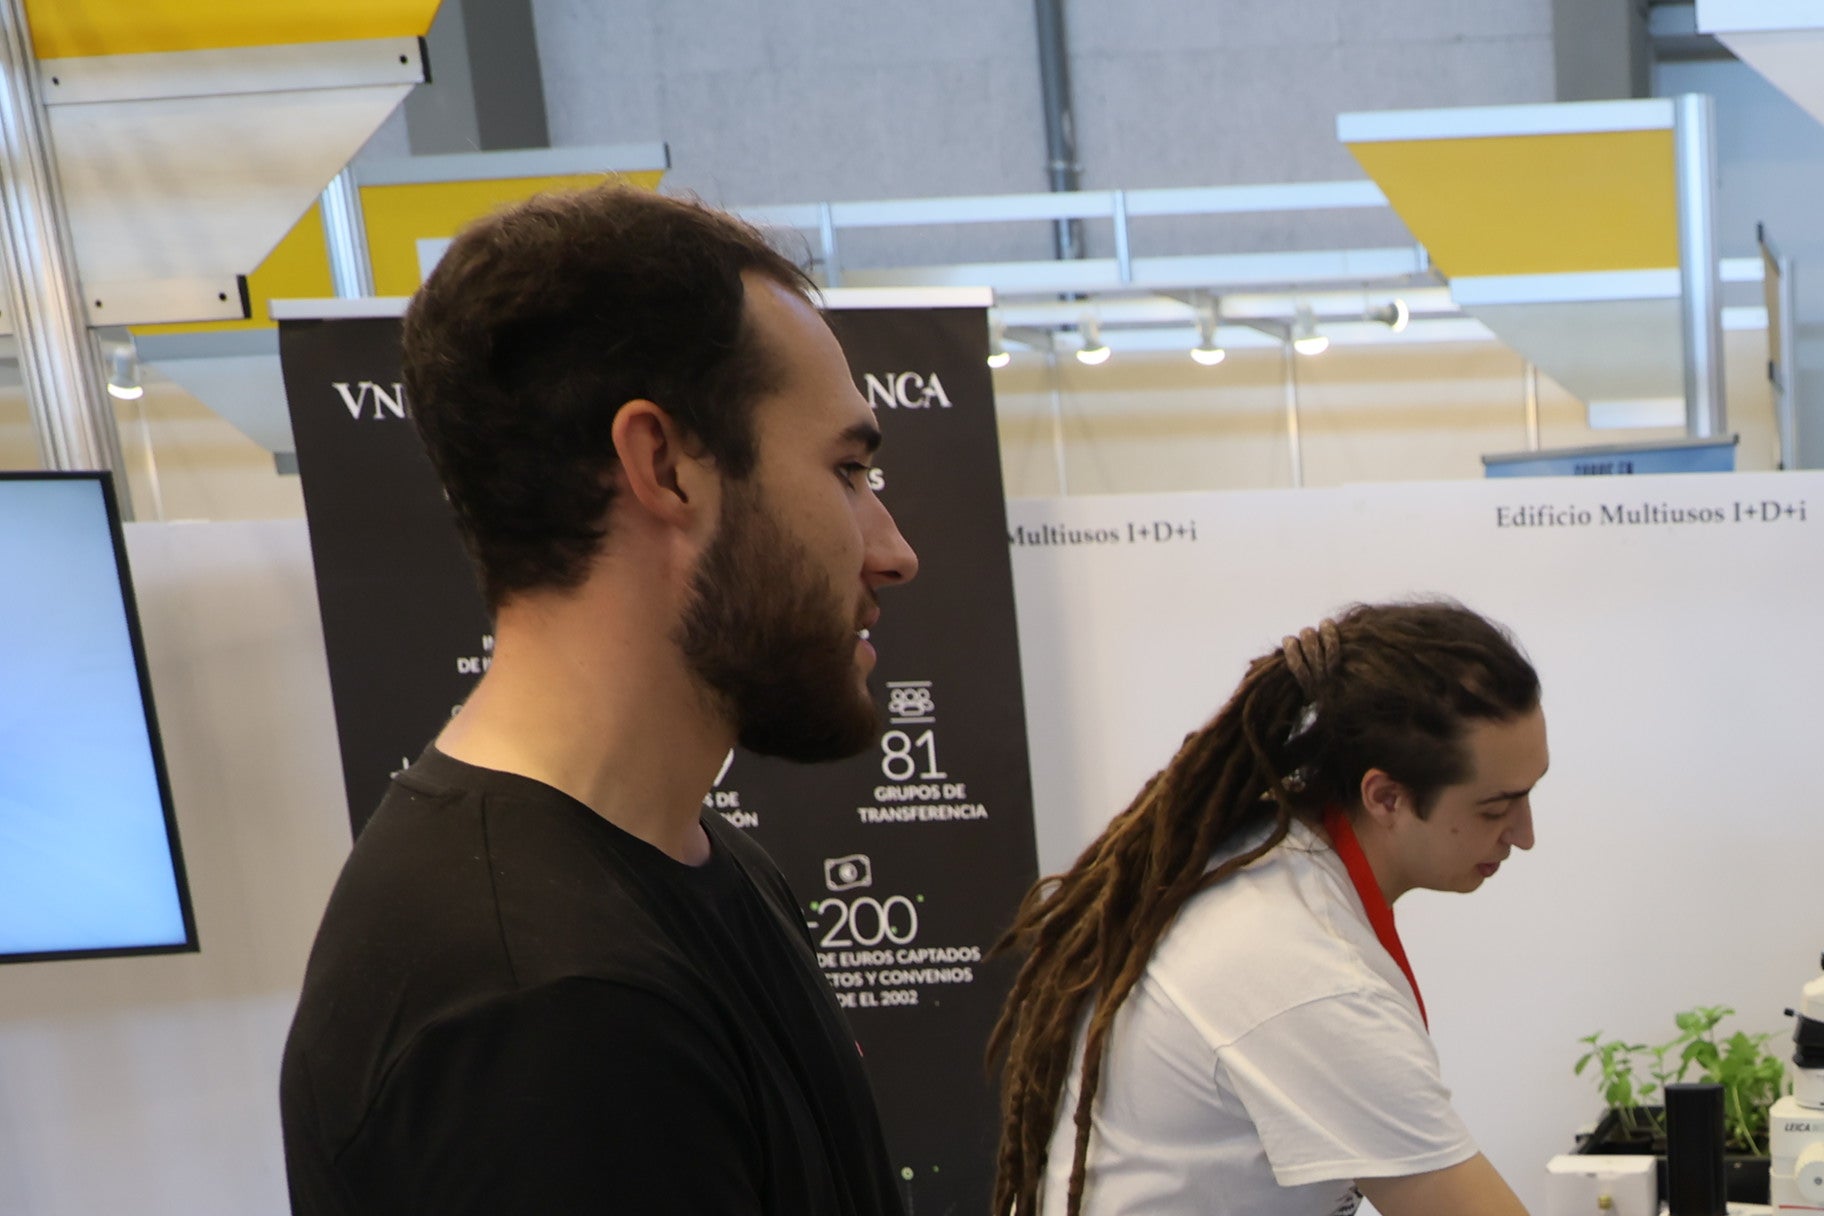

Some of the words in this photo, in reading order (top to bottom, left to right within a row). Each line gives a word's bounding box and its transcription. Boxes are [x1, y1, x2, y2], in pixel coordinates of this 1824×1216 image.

[332, 381, 413, 420] VN
[1496, 504, 1591, 528] Edificio
[1601, 502, 1724, 526] Multiusos
[1733, 499, 1807, 522] I+D+i
[1127, 519, 1197, 542] I+D+i
[457, 657, 480, 674] DE
[881, 729, 947, 781] 81
[874, 784, 941, 802] GRUPOS
[942, 783, 967, 800] DE
[857, 804, 988, 824] TRANSFERENCIA
[839, 950, 894, 968] EUROS
[896, 946, 981, 964] CAPTADOS
[866, 971, 877, 986] Y
[878, 967, 973, 986] CONVENIOS
[859, 991, 878, 1007] EL
